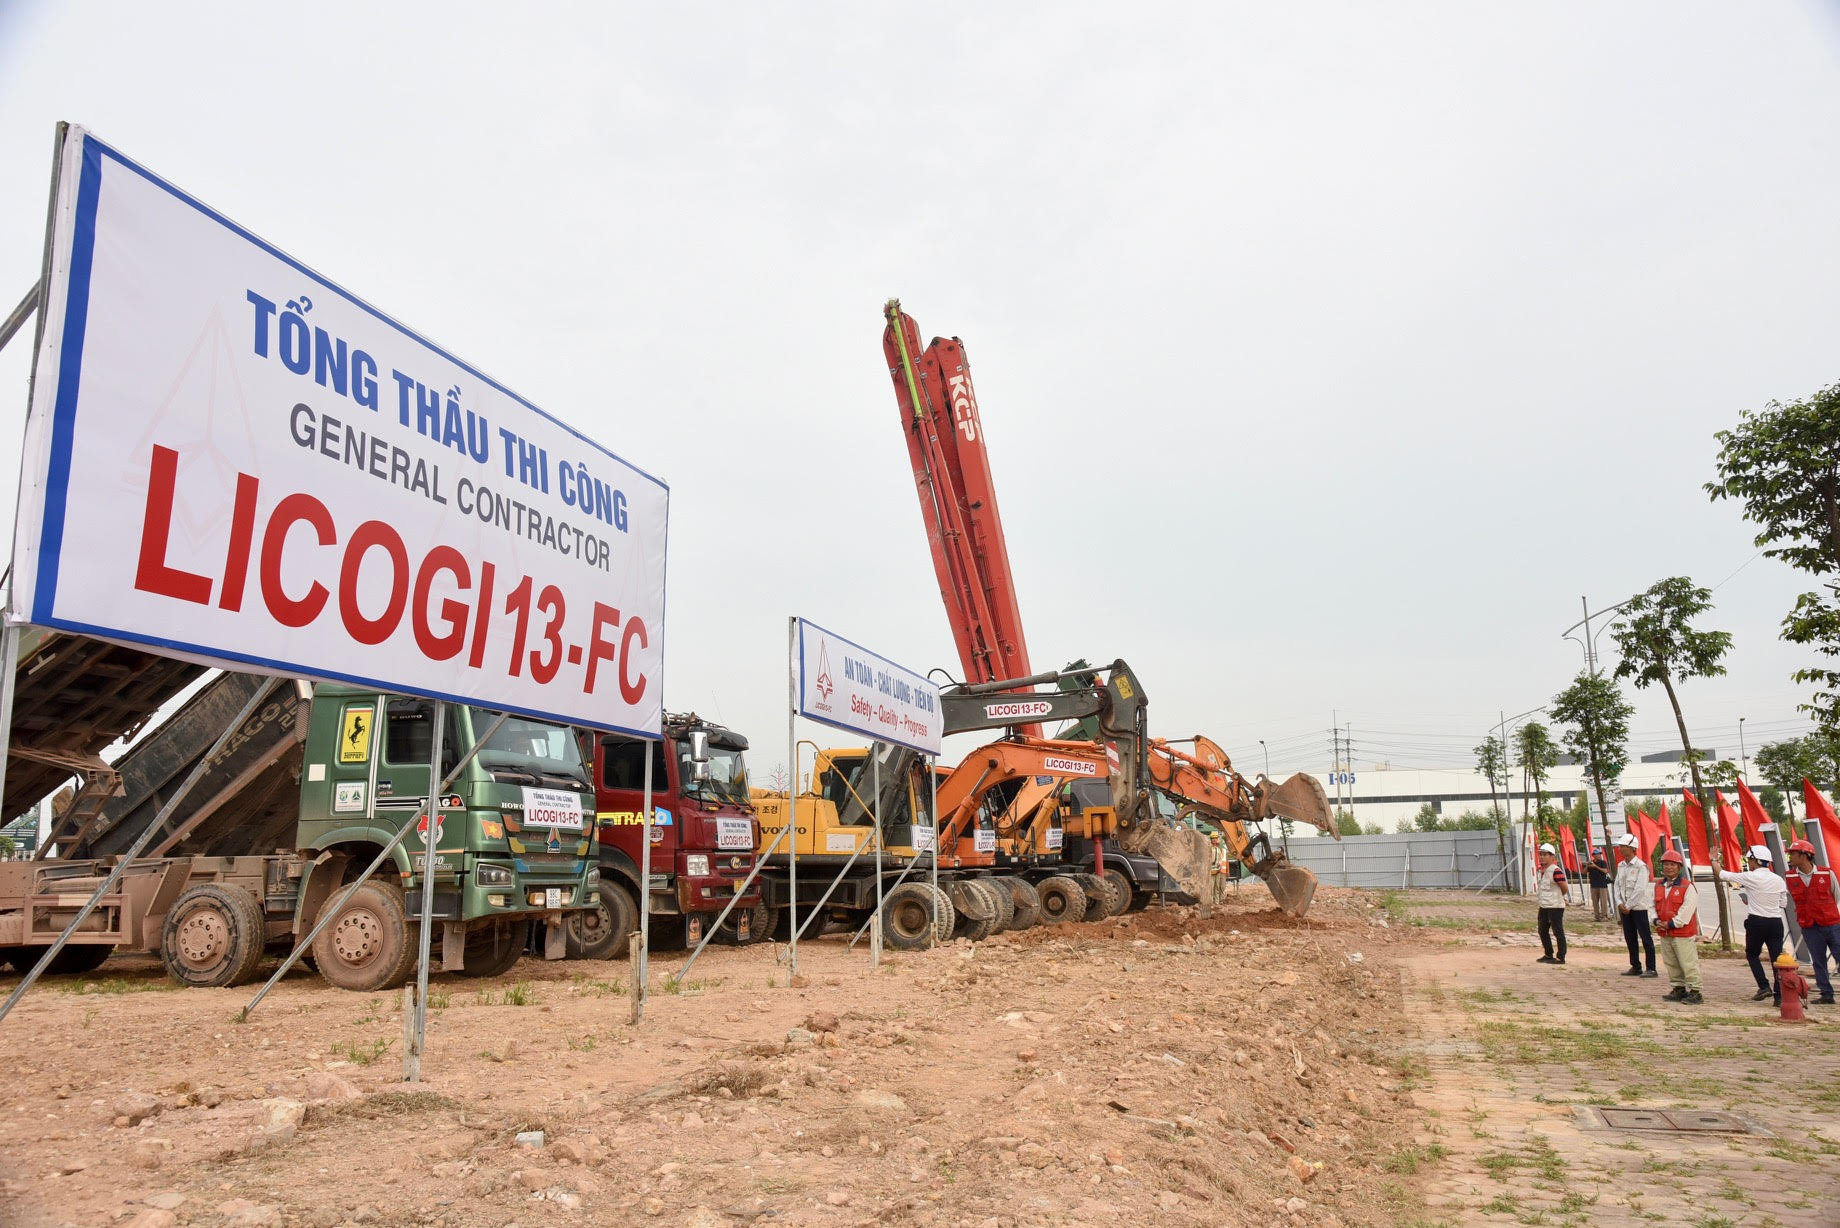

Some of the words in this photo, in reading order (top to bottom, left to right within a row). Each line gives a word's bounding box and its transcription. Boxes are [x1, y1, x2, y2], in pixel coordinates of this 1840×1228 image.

[247, 289, 378, 412] TỔNG
[392, 368, 489, 464] THẦU
[499, 426, 549, 494] THI
[559, 460, 628, 533] CÔNG
[949, 375, 976, 442] KCP
[290, 403, 447, 505] GENERAL
[457, 477, 610, 572] CONTRACTOR
[845, 656, 854, 680] AN
[851, 694, 872, 721] Safety
[879, 704, 898, 731] Quality
[904, 714, 927, 737] Progress
[416, 856, 445, 866] TUO
